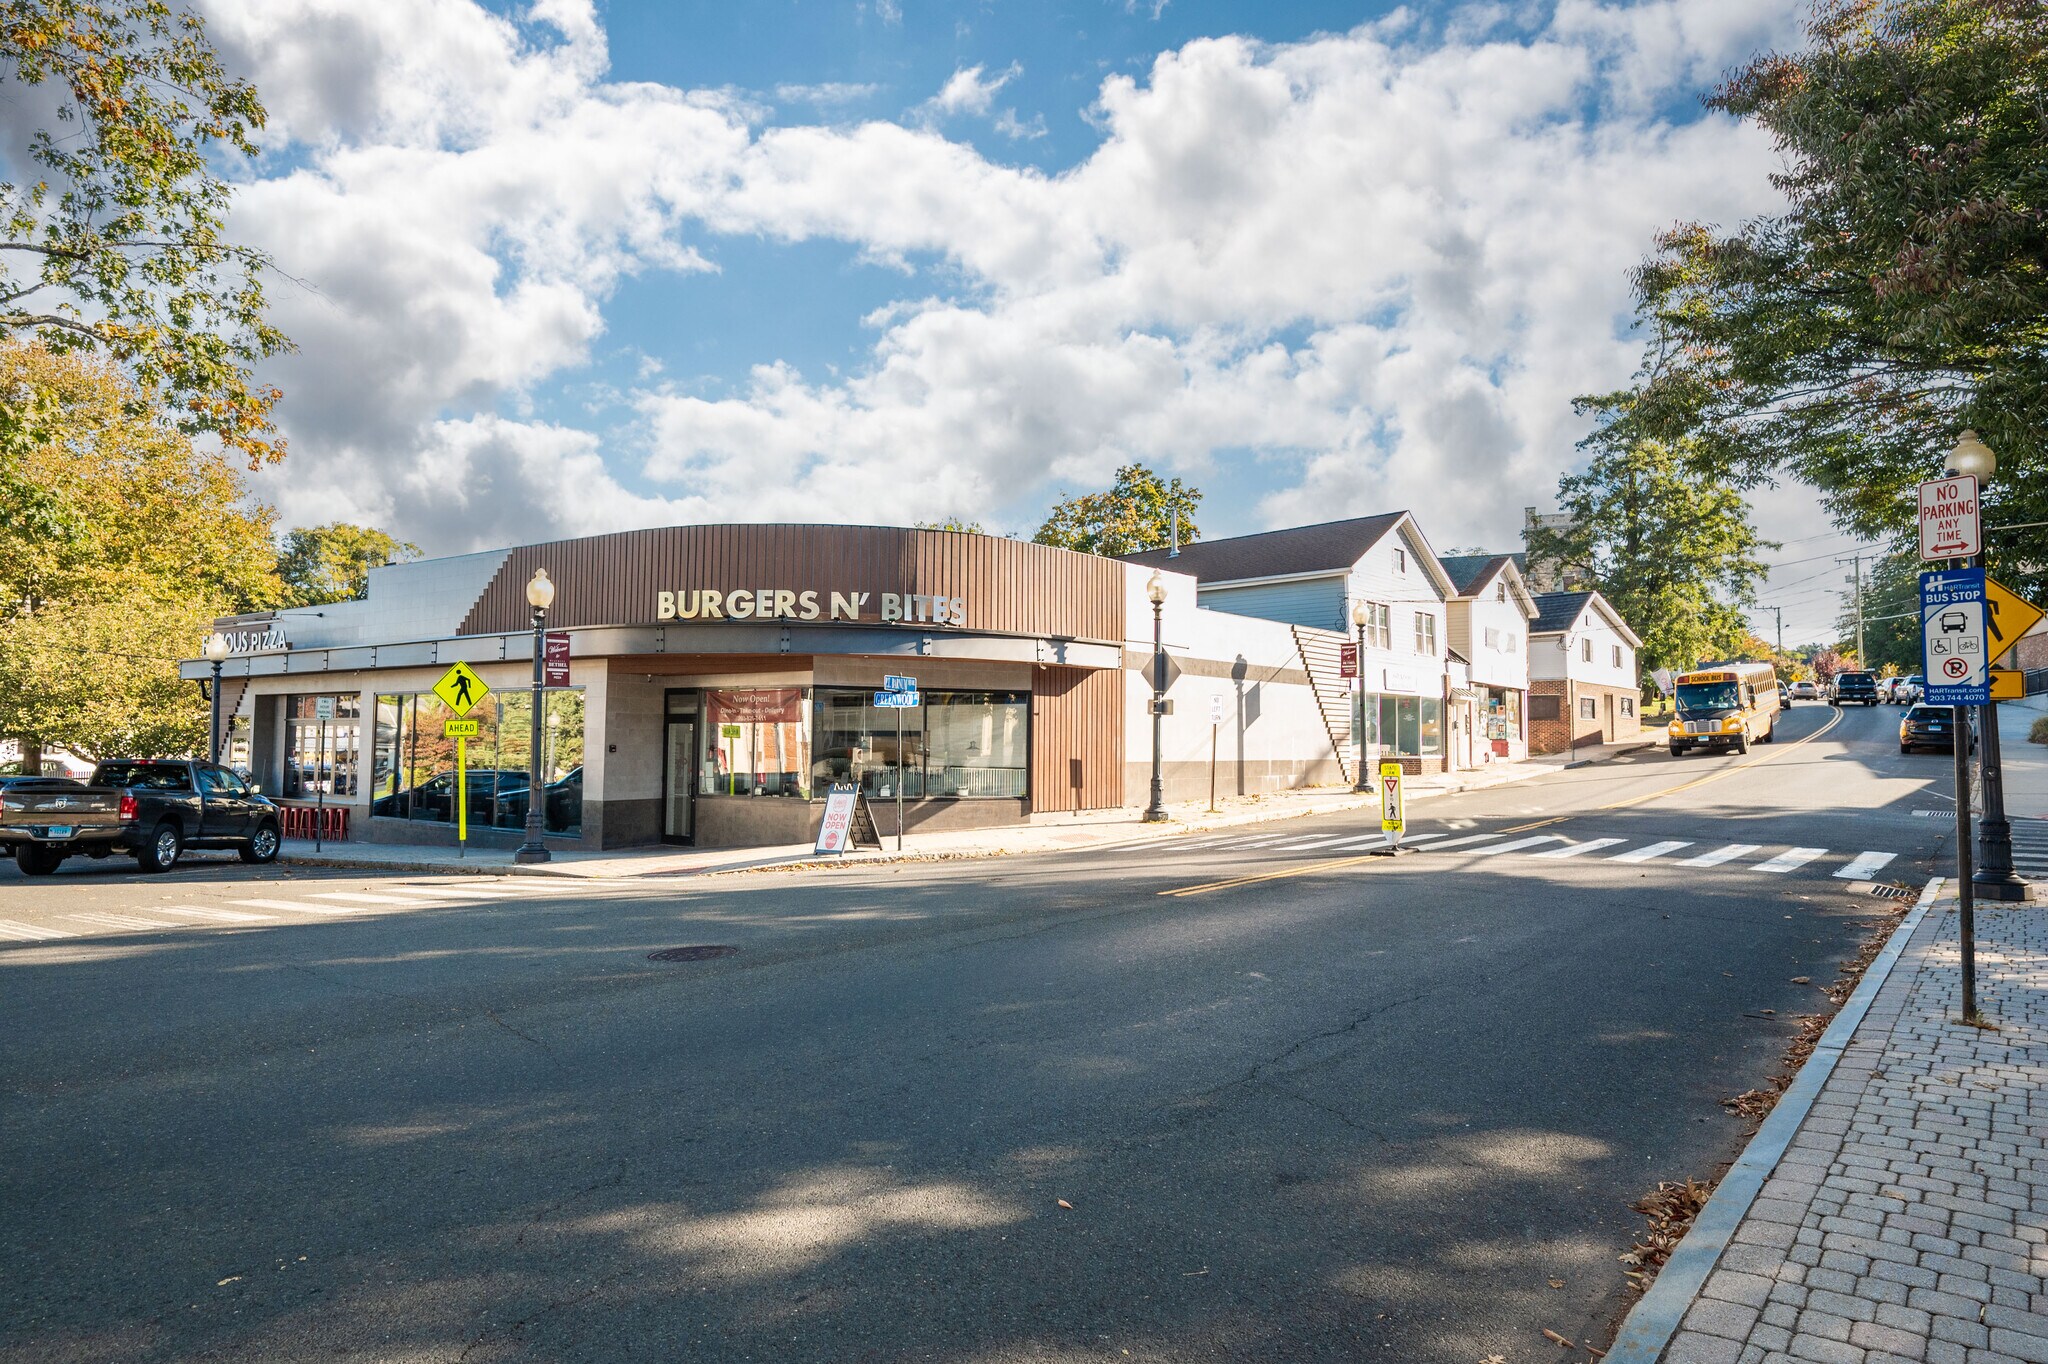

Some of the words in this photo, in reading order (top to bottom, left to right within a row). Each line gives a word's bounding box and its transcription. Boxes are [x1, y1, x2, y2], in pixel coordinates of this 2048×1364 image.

[1936, 484, 1958, 501] NO
[1923, 499, 1974, 521] PARKING
[1938, 518, 1960, 530] ANY
[1936, 530, 1962, 542] TIME
[1926, 593, 1949, 603] BUS
[1951, 590, 1981, 601] STOP
[657, 589, 820, 620] BURGERS
[830, 591, 870, 620] N'
[881, 592, 966, 625] BITES
[202, 631, 248, 655] FOUS
[251, 630, 288, 651] PIZZA
[732, 695, 748, 703] Now
[750, 694, 770, 704] Open!
[875, 694, 913, 705] GREENWOOD
[448, 724, 475, 732] AHEAD
[827, 813, 848, 821] NOW
[825, 821, 846, 829] OPEN
